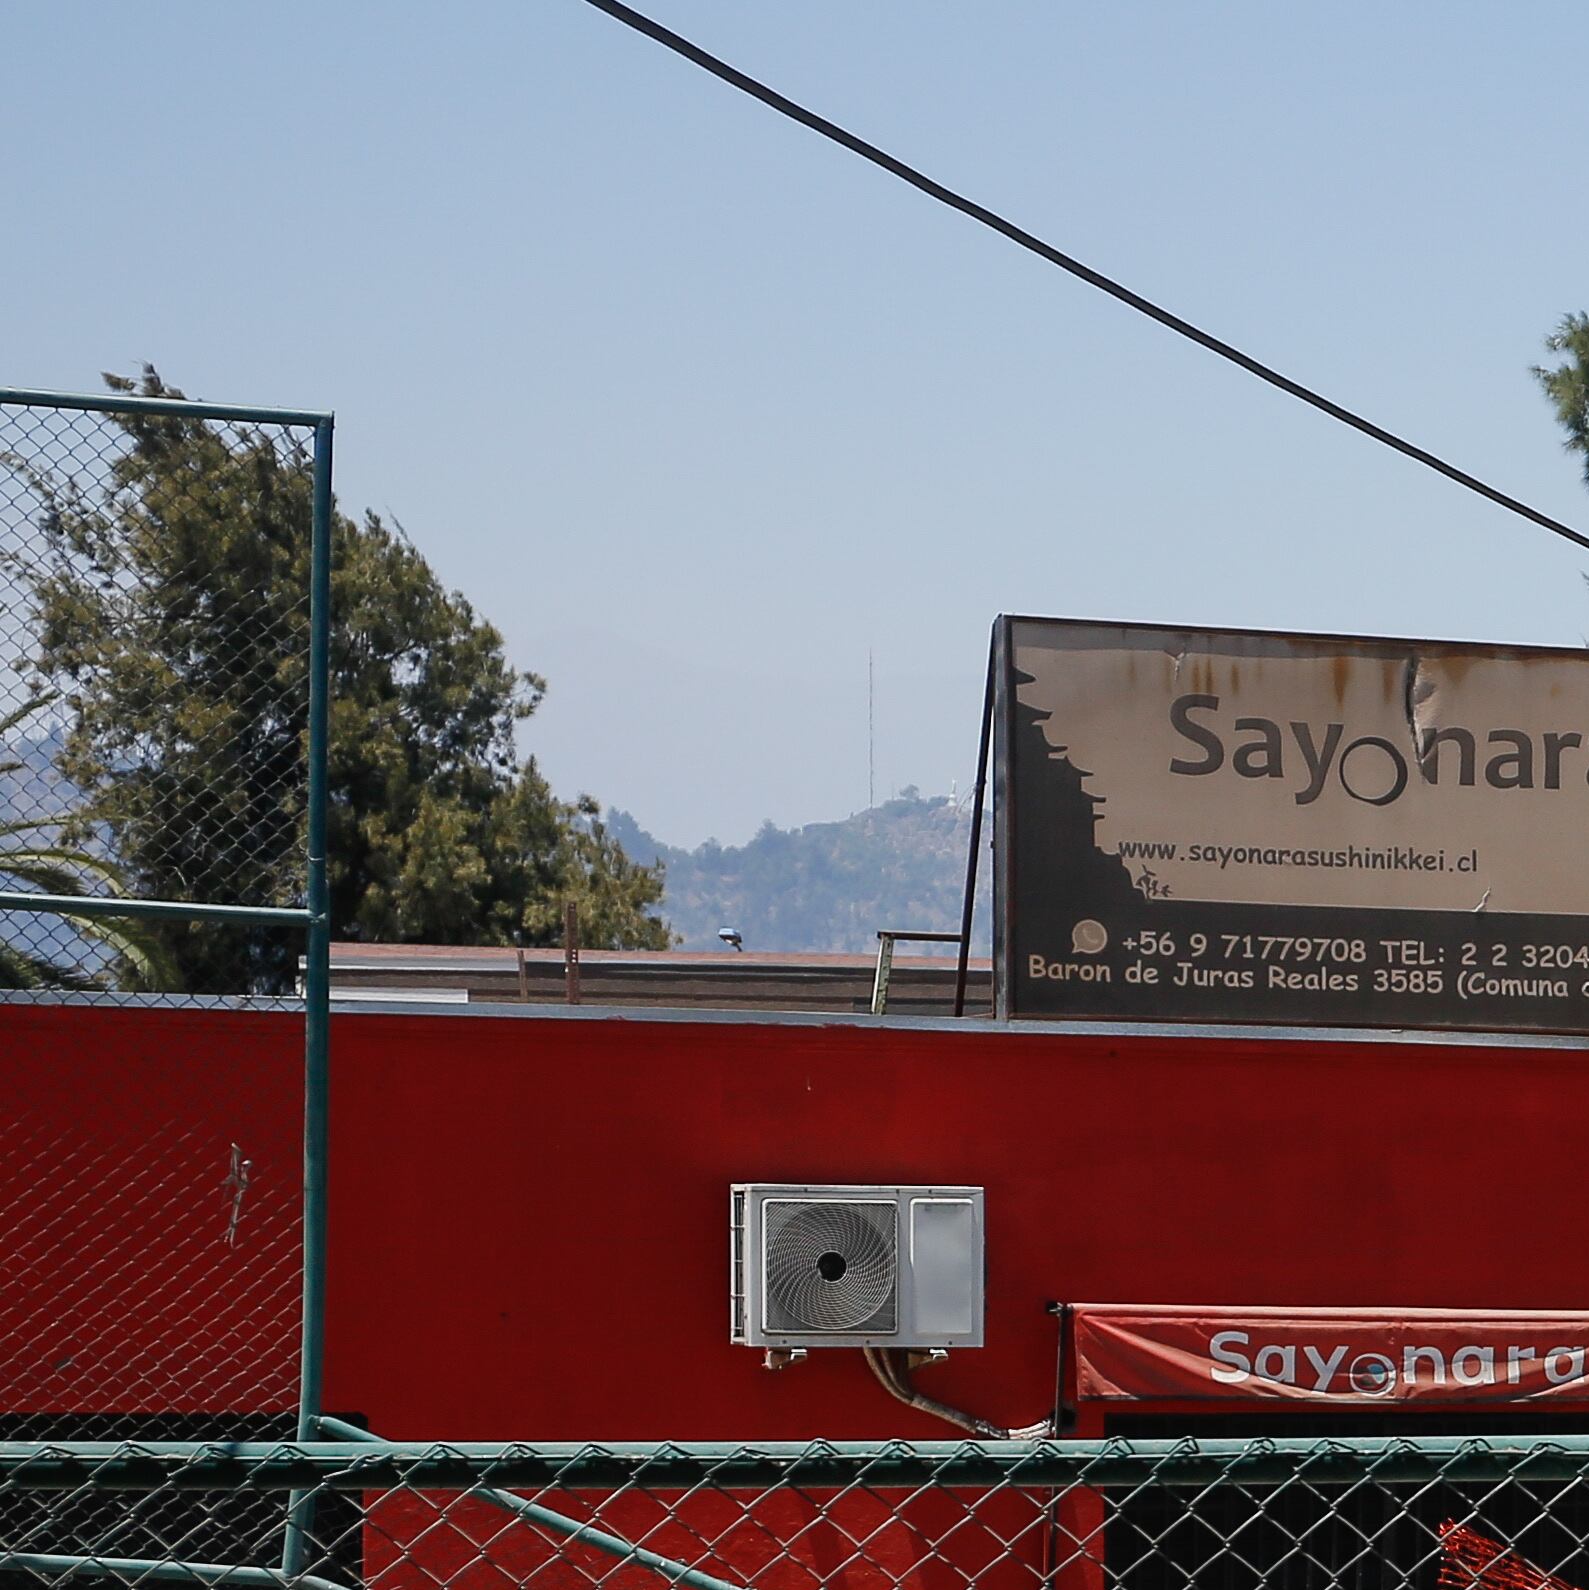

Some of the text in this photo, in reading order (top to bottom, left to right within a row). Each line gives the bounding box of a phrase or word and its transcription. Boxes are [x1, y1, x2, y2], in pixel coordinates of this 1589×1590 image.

[1118, 840, 1479, 873] www.sayonarasushinikkei.cl
[1122, 930, 1176, 957] +56
[1189, 933, 1208, 958] 9
[1219, 934, 1367, 962] 71779708
[1379, 939, 1445, 966] TEL:
[1460, 942, 1478, 967] 2
[1491, 943, 1508, 967] 2
[1028, 954, 1112, 983] Baron
[1124, 960, 1160, 984] de
[1173, 961, 1255, 988] Juras
[1267, 965, 1360, 992] Reales
[1372, 969, 1444, 994] 3585
[1456, 971, 1569, 999] (Comuna
[1209, 1331, 1585, 1398] Sayonara
